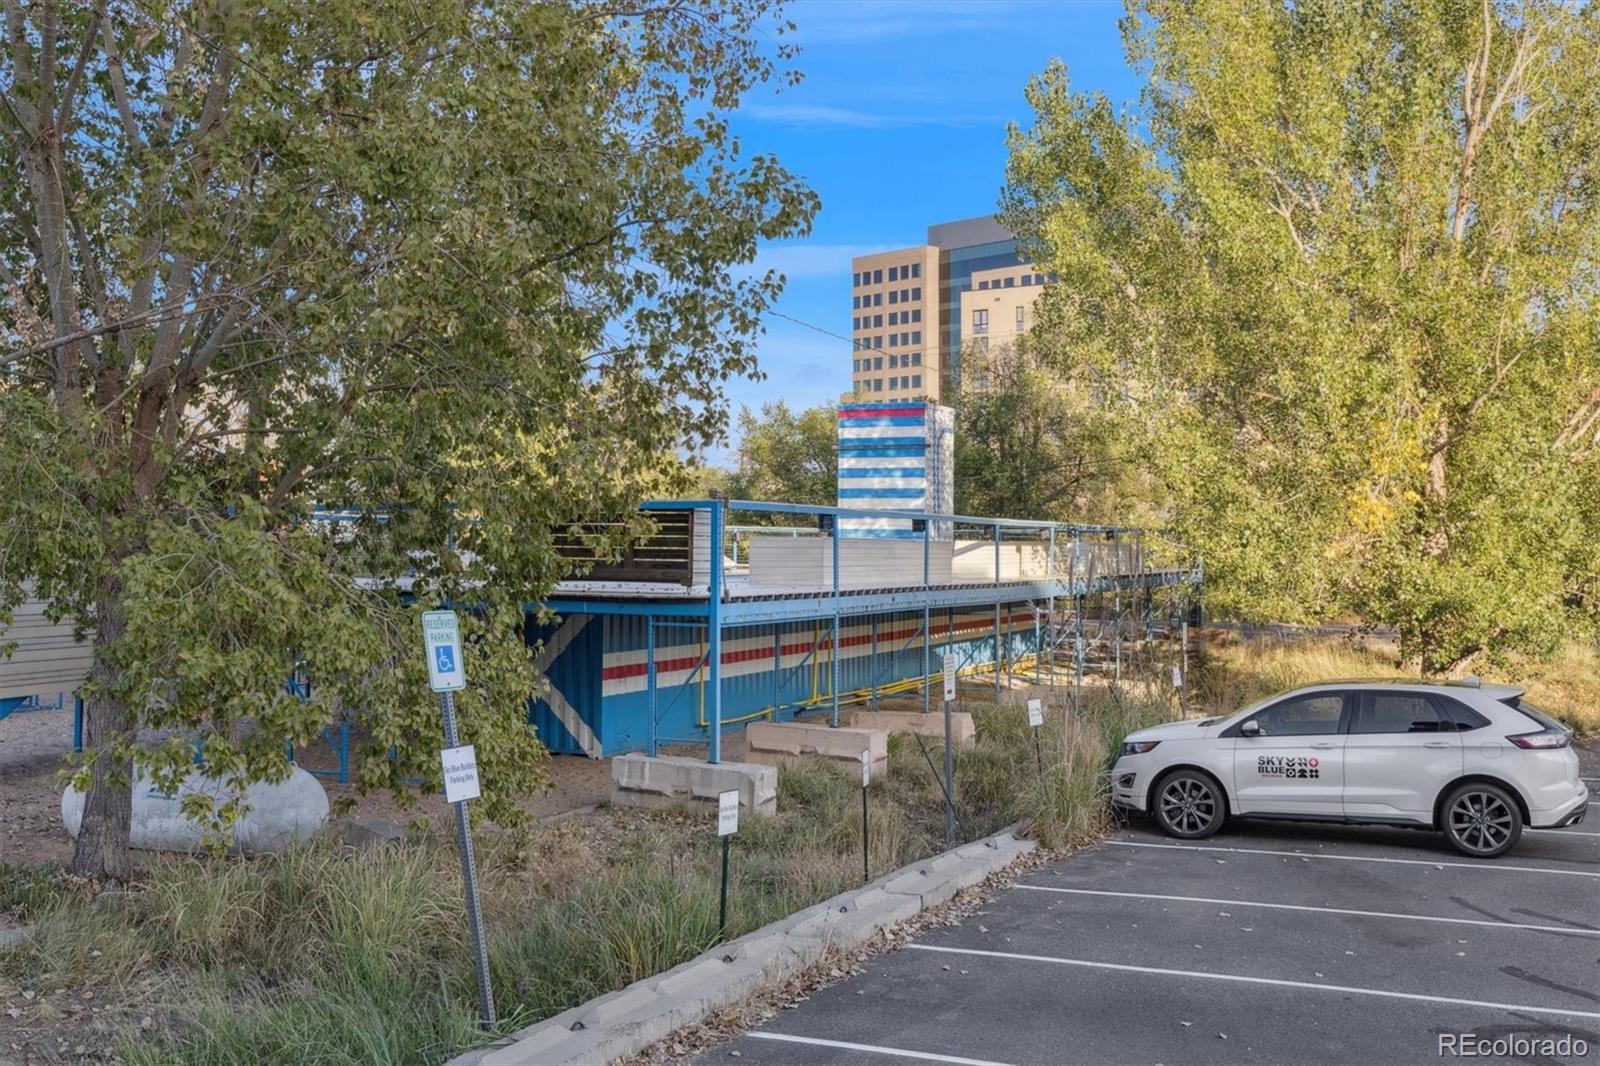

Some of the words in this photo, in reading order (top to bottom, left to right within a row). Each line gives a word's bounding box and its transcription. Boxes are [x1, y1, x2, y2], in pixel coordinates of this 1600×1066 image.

[425, 619, 455, 629] RESERVED
[430, 631, 454, 641] PARKING
[1258, 756, 1284, 766] SKY
[1258, 766, 1285, 774] BLUE
